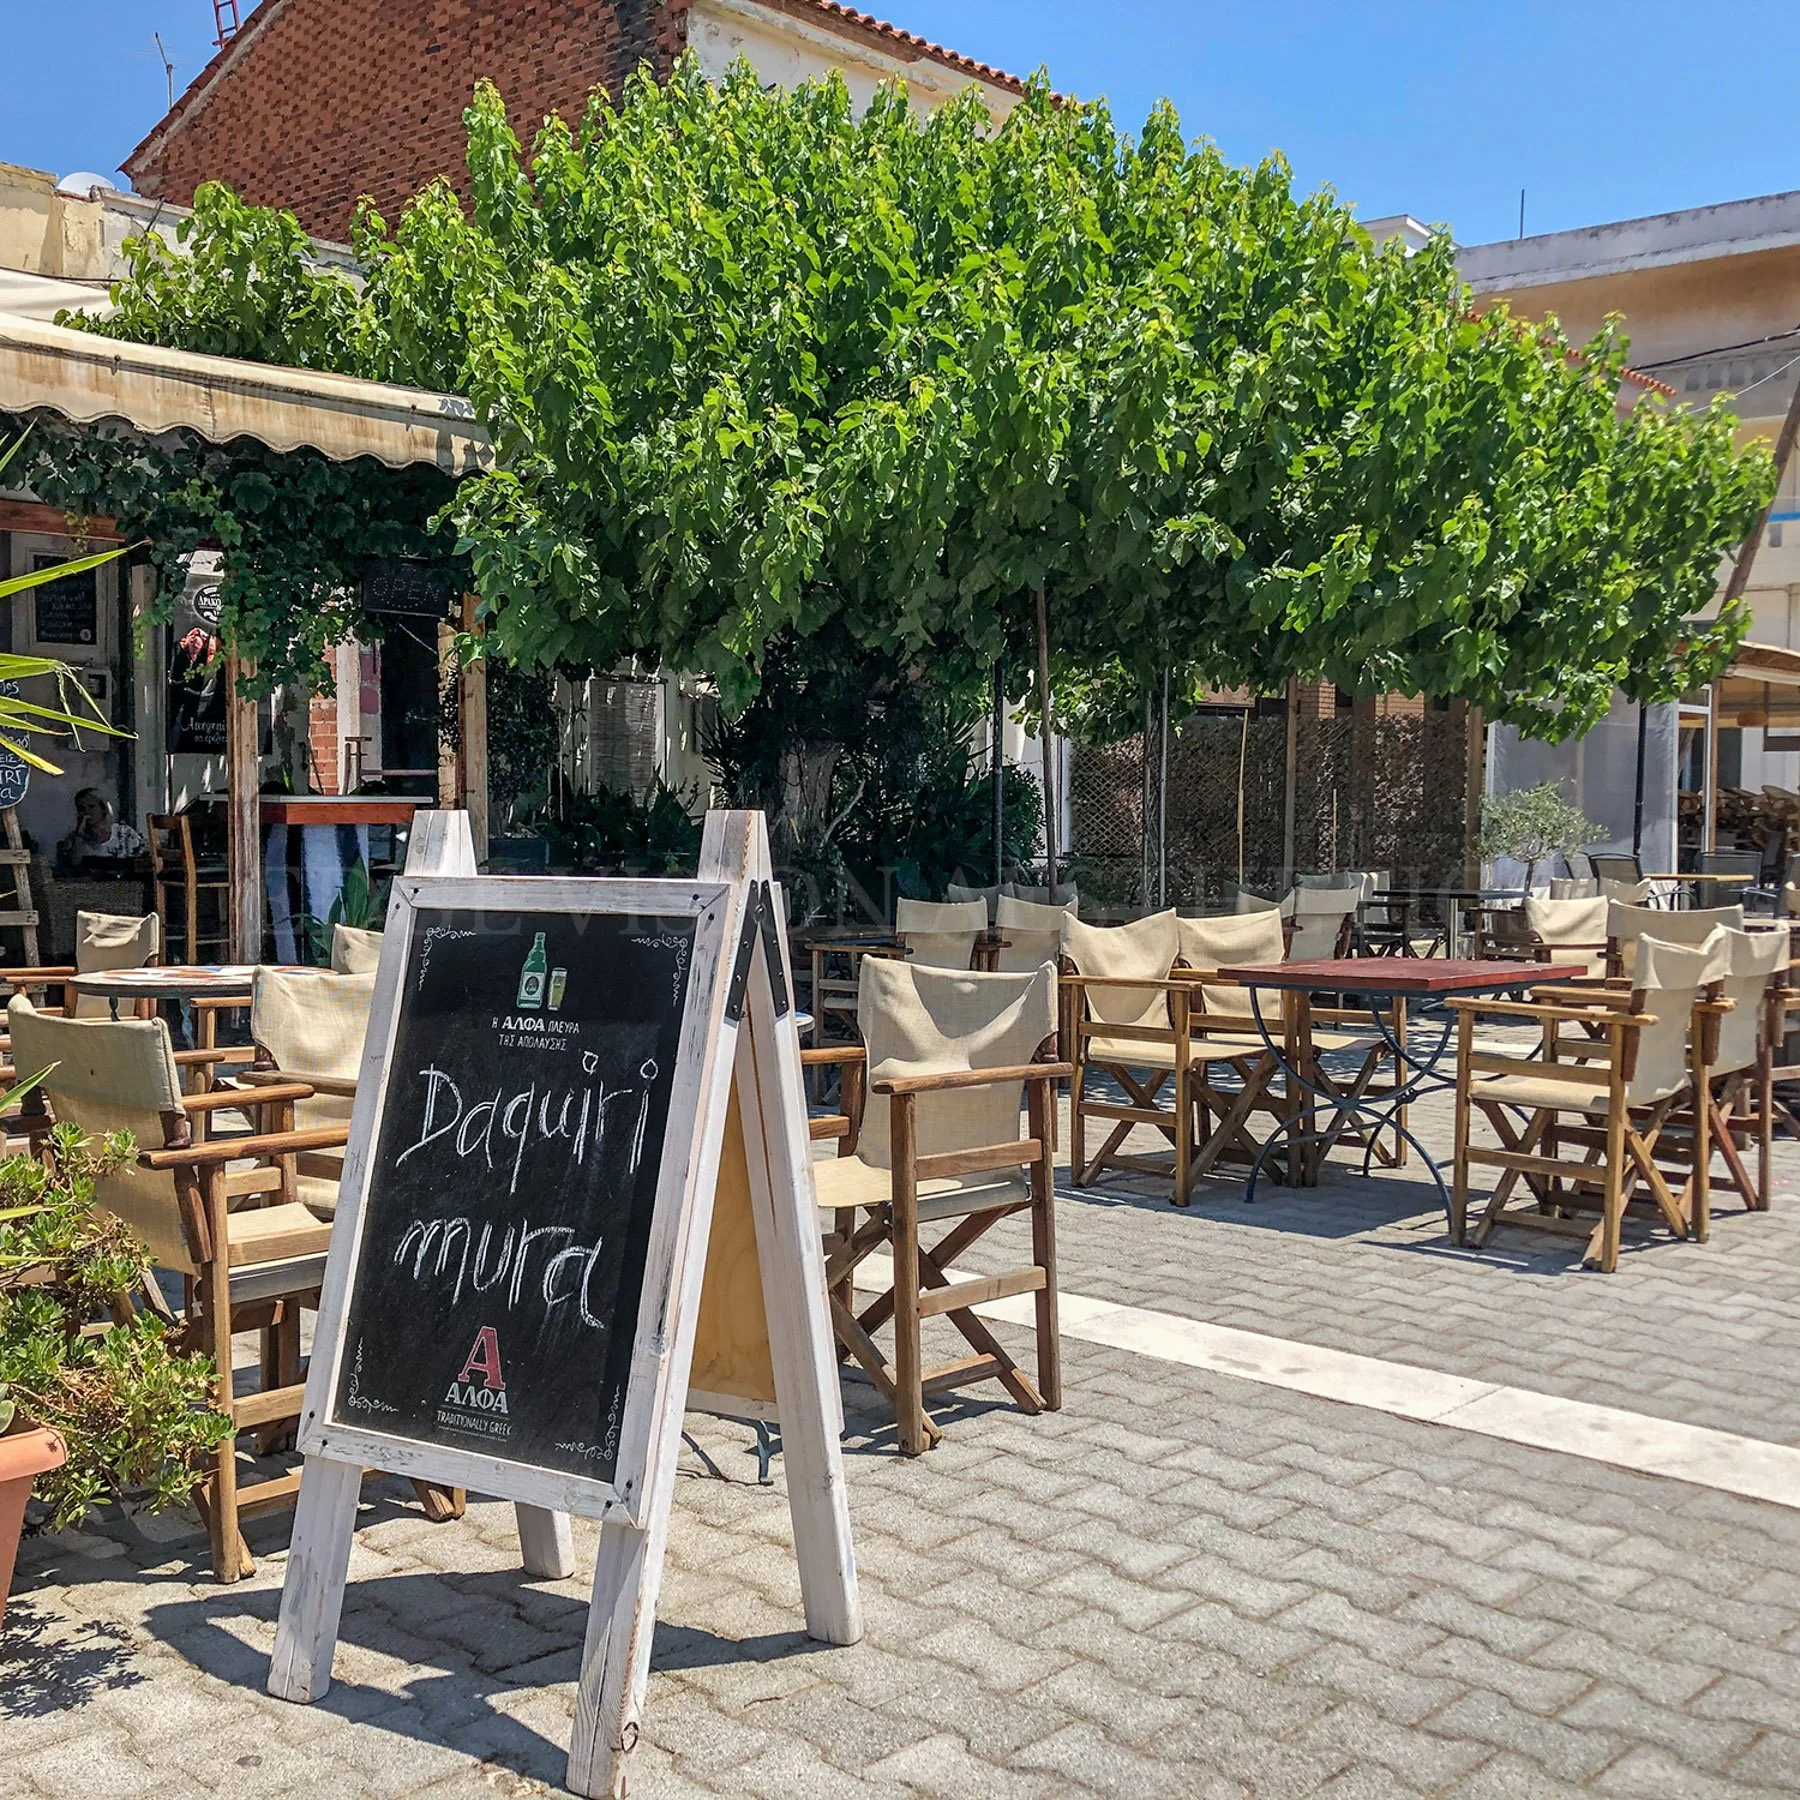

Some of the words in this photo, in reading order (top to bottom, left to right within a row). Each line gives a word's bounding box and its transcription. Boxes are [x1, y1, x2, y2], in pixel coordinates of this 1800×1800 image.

[372, 576, 440, 602] OPEN
[501, 1016, 545, 1032] ΑΛΦΑ
[396, 1050, 660, 1194] Daquiri
[394, 1216, 604, 1330] mura
[444, 1382, 509, 1414] ΑΛΦΑ
[437, 1410, 488, 1432] TRADITIONALLY
[489, 1421, 512, 1437] GREEK
